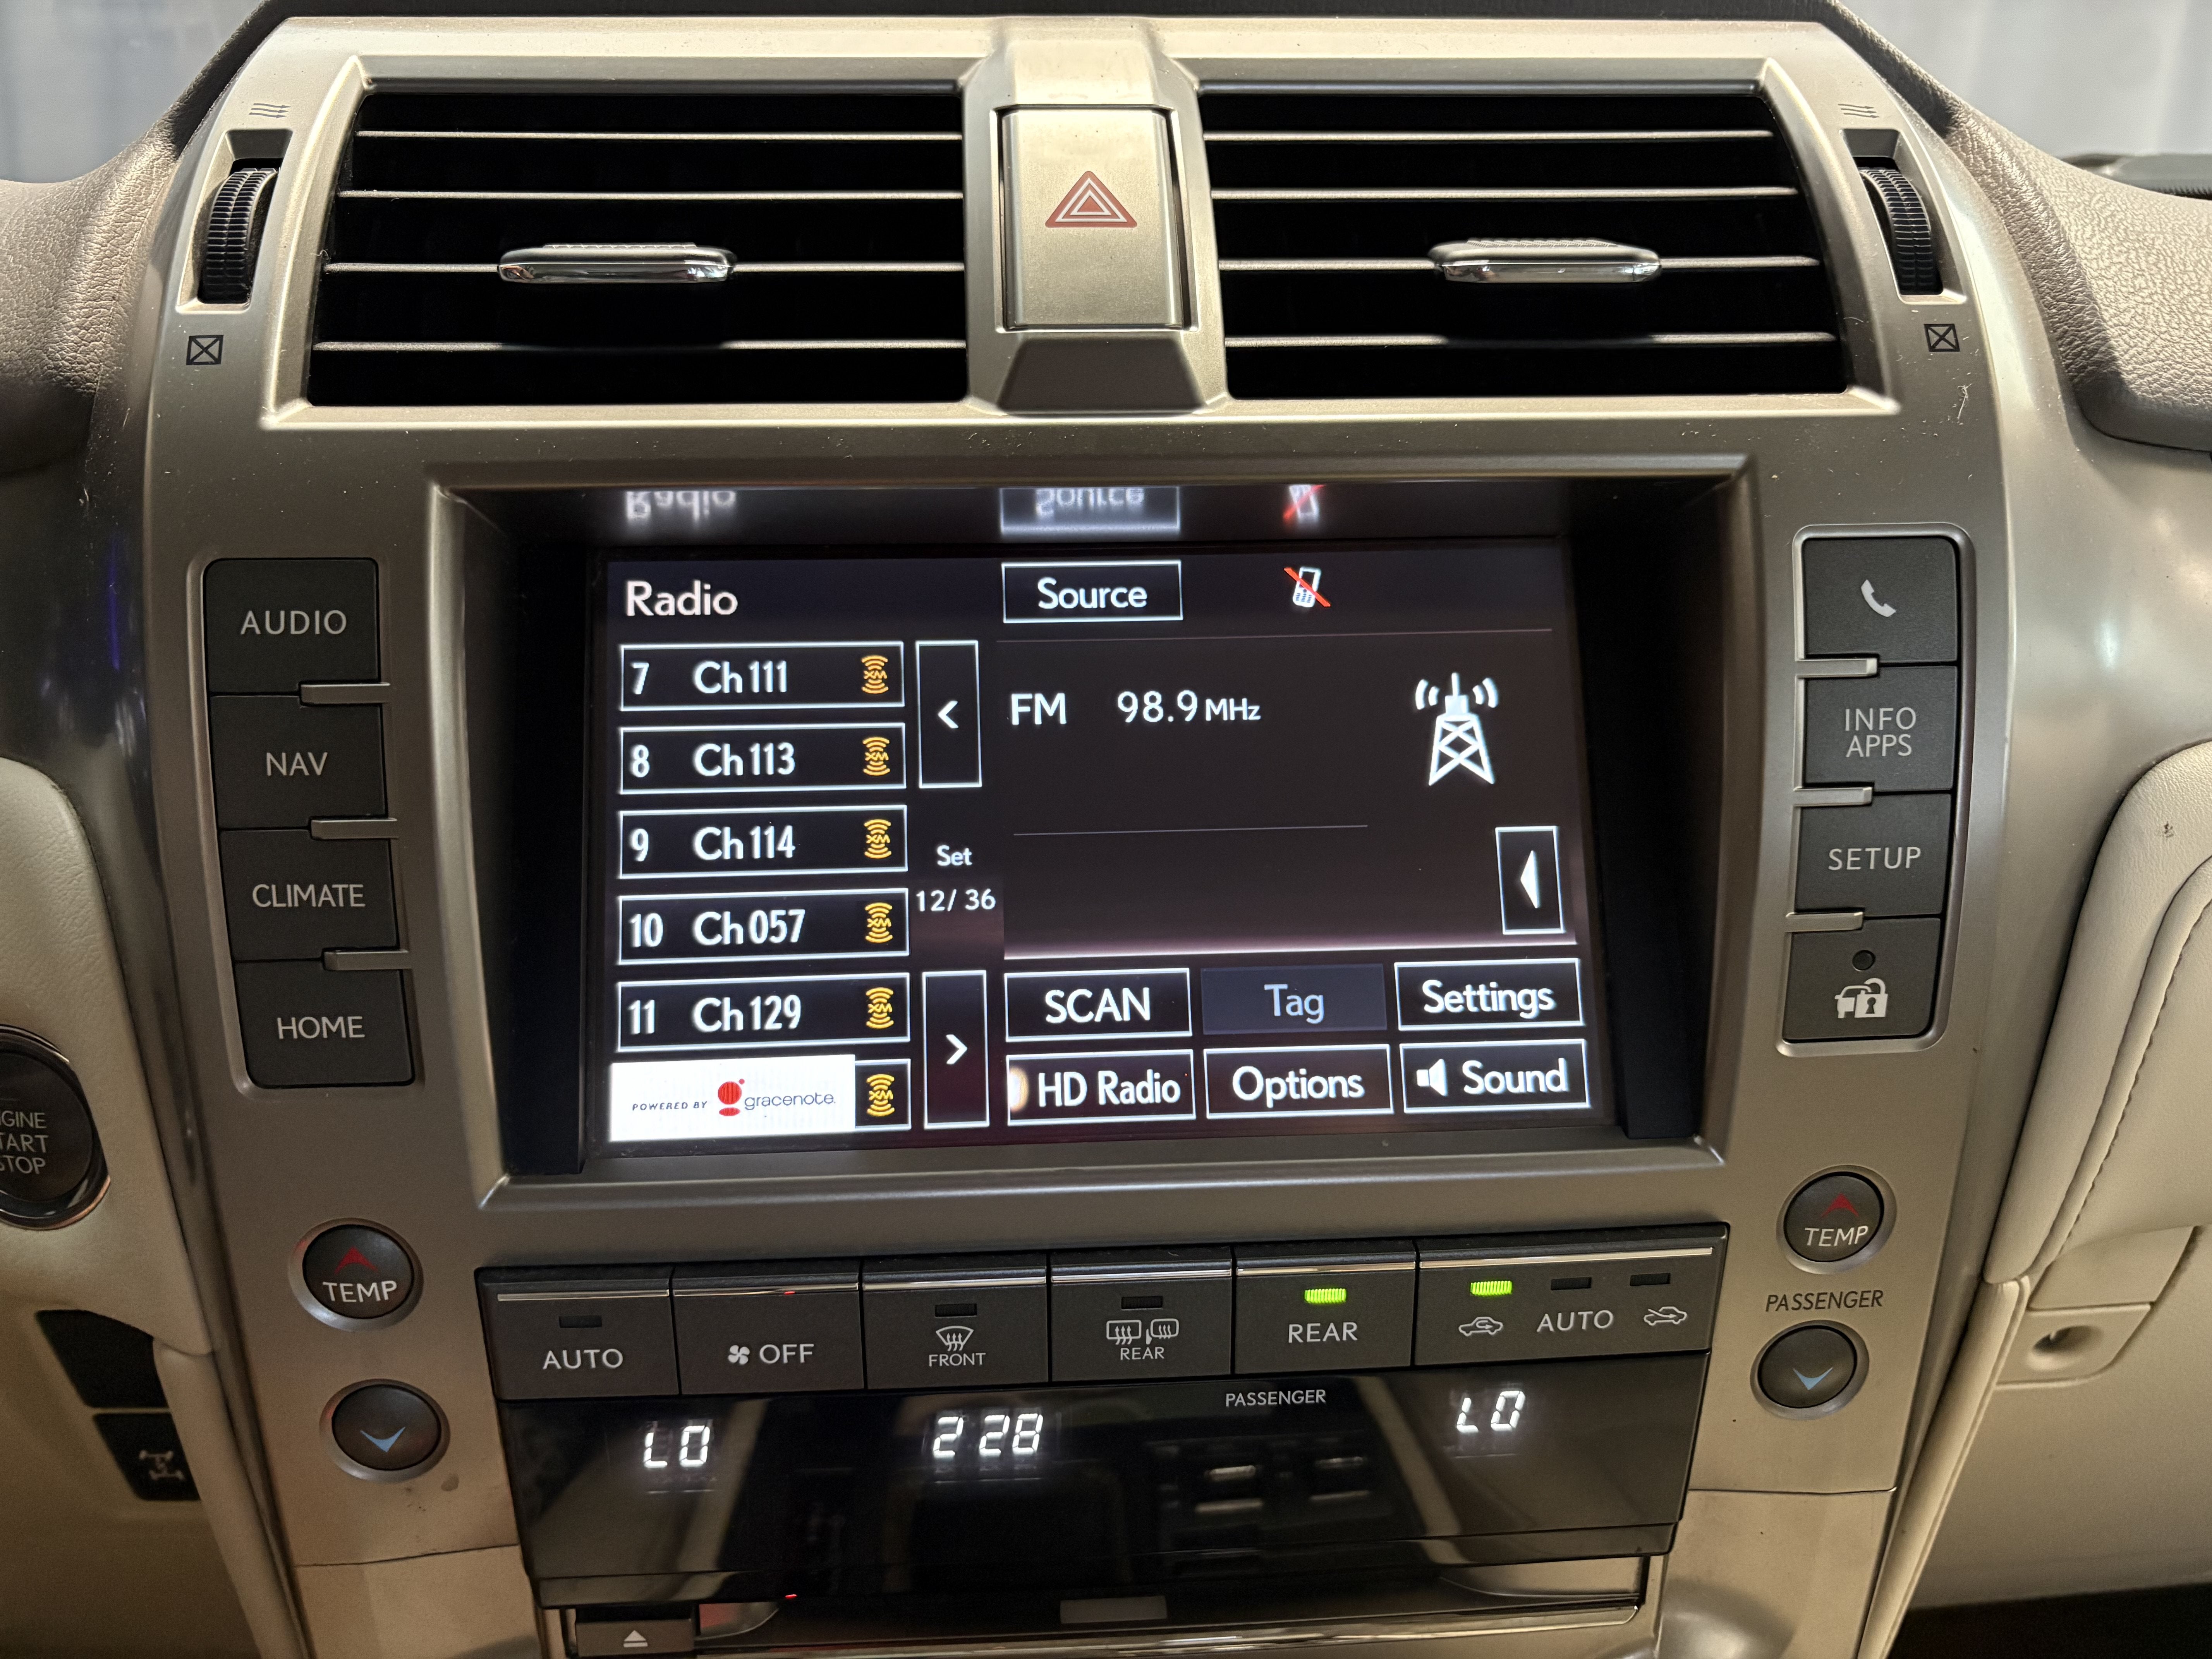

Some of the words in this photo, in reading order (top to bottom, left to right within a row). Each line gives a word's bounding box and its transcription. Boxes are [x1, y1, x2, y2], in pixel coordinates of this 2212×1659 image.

[627, 580, 738, 616] Radio
[1037, 577, 1147, 609] Source
[240, 610, 347, 635] AUDIO
[632, 662, 649, 695] 7
[1011, 692, 1067, 725] FM
[1117, 690, 1198, 723] 98.9
[1205, 697, 1261, 721] MHz
[1845, 707, 1916, 731] INFO
[1846, 733, 1912, 757] APPS
[266, 752, 328, 776] NAV
[630, 744, 650, 778] 8
[630, 828, 649, 862] 9
[936, 845, 972, 866] Set
[1829, 847, 1921, 870] SETUP
[252, 884, 366, 907] CLIMATE
[630, 913, 663, 947] 10
[1045, 987, 1151, 1024] SCAN
[1264, 984, 1324, 1024] Tag
[1422, 979, 1556, 1019] Settings
[277, 1016, 365, 1039] HOME
[629, 1000, 655, 1034] 11
[1038, 1071, 1087, 1107] HD
[1098, 1069, 1181, 1105] Radio
[1232, 1066, 1365, 1108] Options
[1462, 1058, 1569, 1094] Sound
[632, 1102, 688, 1111] POWERED
[0, 1110, 47, 1128] GINE
[1805, 1225, 1869, 1247] TEMP
[323, 1280, 397, 1302] TEMP
[1765, 1290, 1884, 1312] PASSENGER
[1288, 1322, 1357, 1343] REAR
[1537, 1310, 1614, 1332] AUTO
[543, 1348, 623, 1369] AUTO
[759, 1343, 814, 1364] OFF
[929, 1352, 986, 1367] FRONT
[1120, 1346, 1164, 1360] REAR
[1226, 1389, 1326, 1407] PASSENGER
